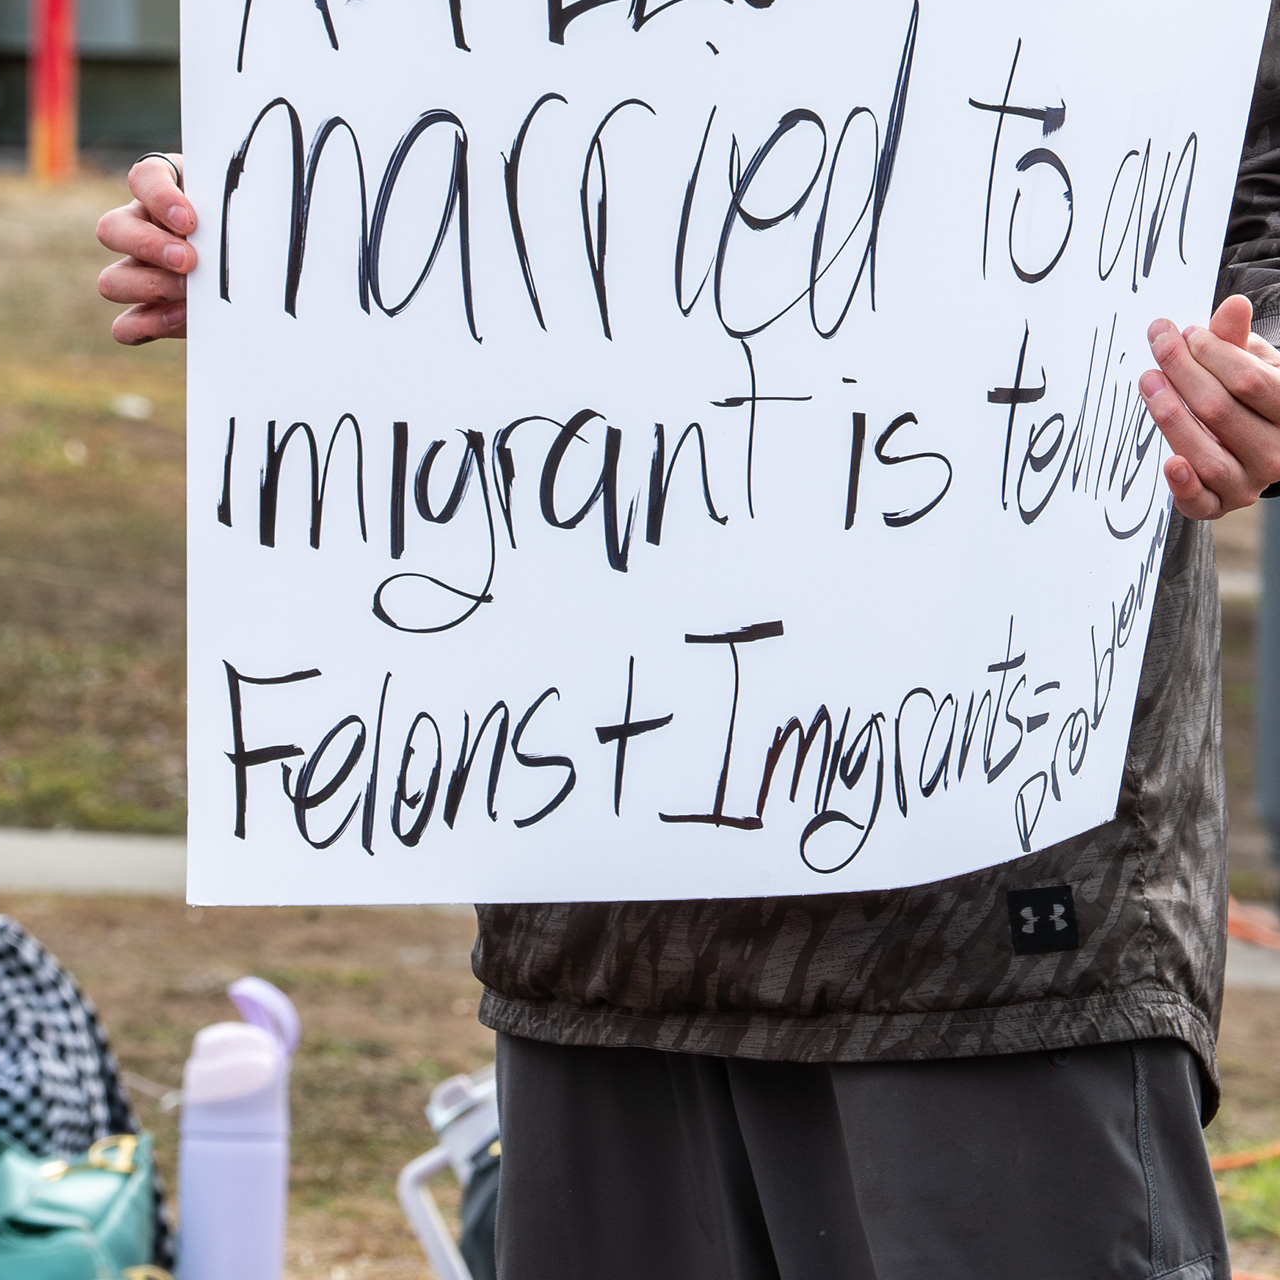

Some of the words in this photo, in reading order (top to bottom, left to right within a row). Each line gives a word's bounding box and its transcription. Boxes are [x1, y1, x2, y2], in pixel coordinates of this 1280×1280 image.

[968, 37, 1073, 285] to
[1098, 131, 1197, 293] an
[842, 376, 953, 530] is
[987, 312, 1163, 540] telling
[222, 659, 577, 856] Felons
